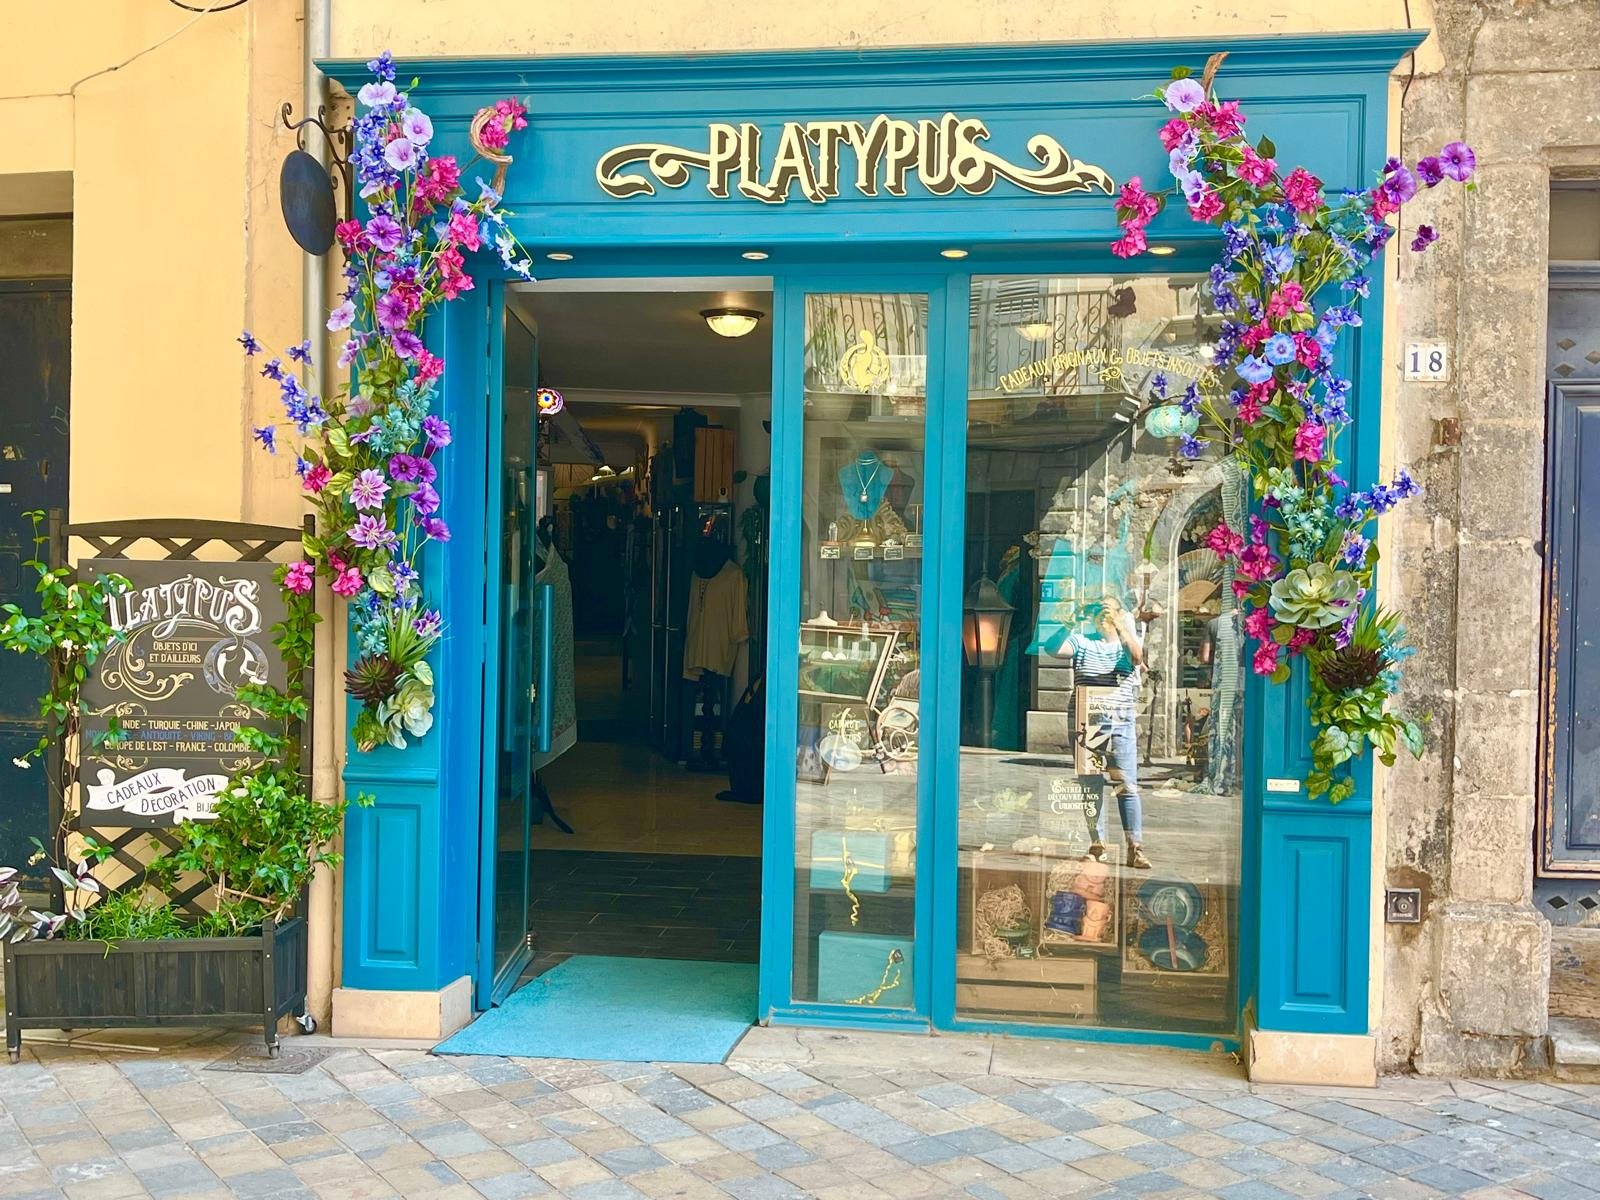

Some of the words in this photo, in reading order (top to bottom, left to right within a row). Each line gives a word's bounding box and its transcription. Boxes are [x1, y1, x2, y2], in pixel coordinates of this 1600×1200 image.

[707, 111, 994, 204] PLATYPUS
[999, 358, 1051, 393] CADEAUX
[1052, 348, 1108, 371] ORIGINAUX
[1109, 348, 1124, 365] &
[1126, 347, 1166, 369] OBJETS
[1410, 350, 1443, 373] 18
[153, 640, 181, 651] OBJETS
[182, 641, 198, 652] D'ICI
[149, 653, 160, 663] ET
[160, 652, 202, 664] D'AILLEURS
[122, 719, 141, 730] INDE
[148, 720, 181, 731] TURQUIE
[135, 740, 146, 751] DE
[146, 740, 168, 751] L'EST
[175, 741, 207, 752] FRANCE
[106, 772, 162, 805] CADEAUX
